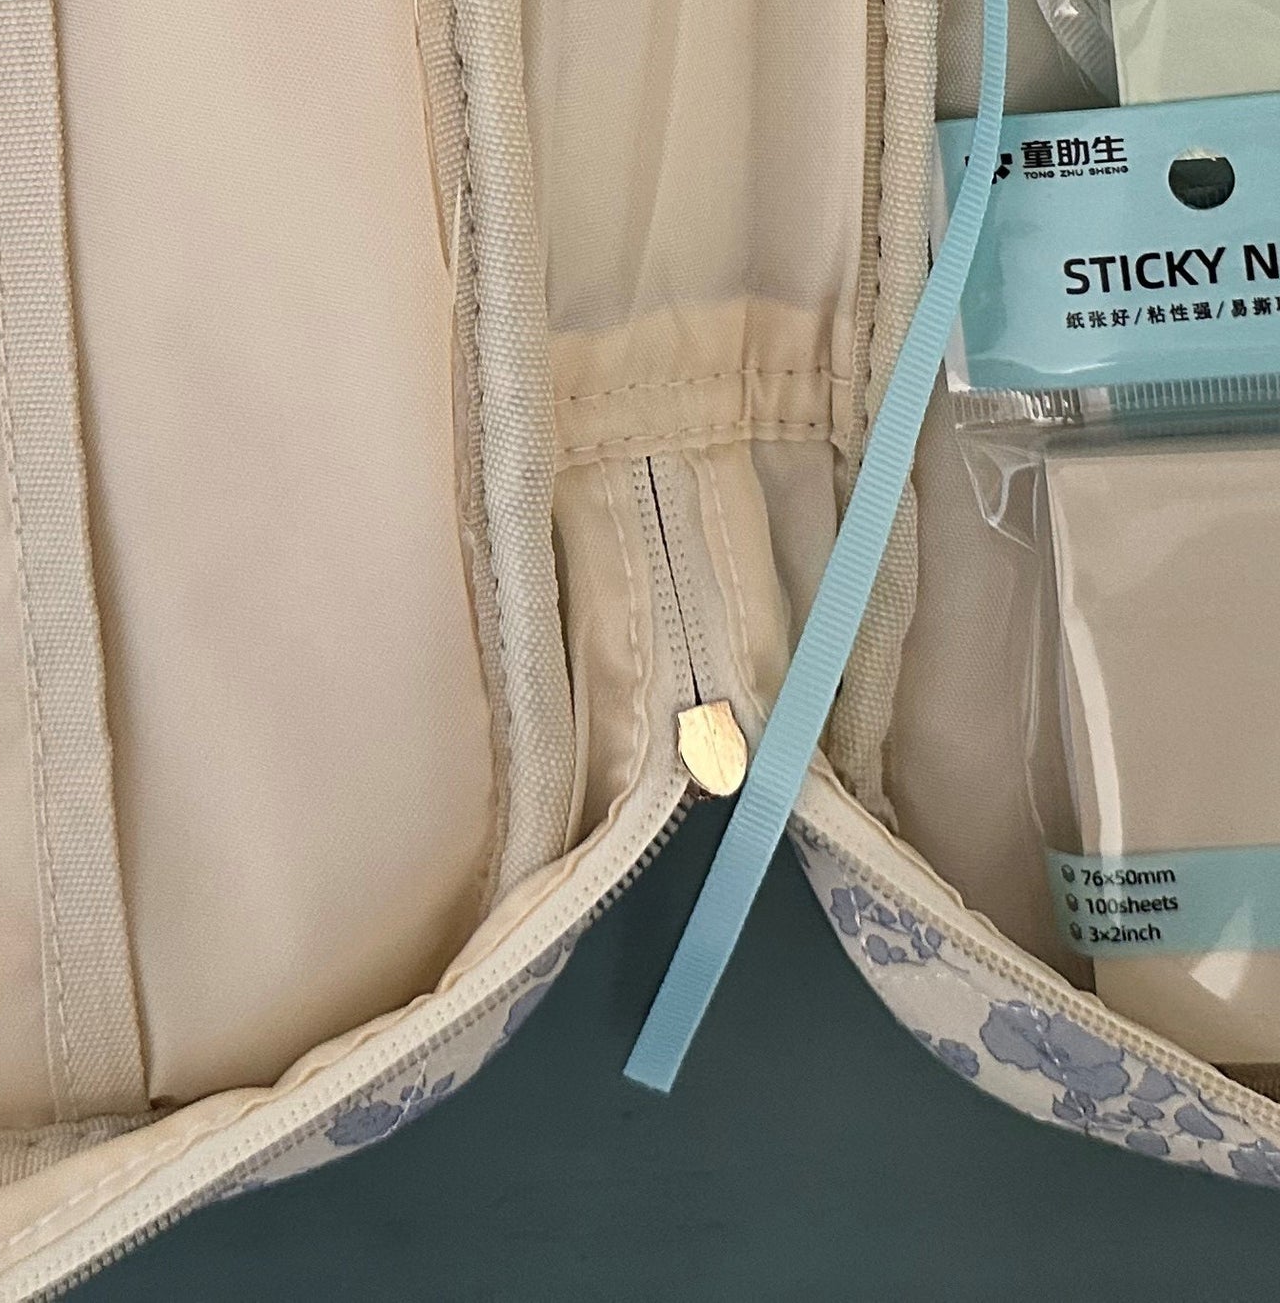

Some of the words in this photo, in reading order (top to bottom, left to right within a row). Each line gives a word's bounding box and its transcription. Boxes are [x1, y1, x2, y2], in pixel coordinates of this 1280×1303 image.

[1020, 135, 1128, 169] 童助生
[1023, 170, 1055, 180] TONG
[1059, 169, 1084, 177] ZHU
[1088, 165, 1129, 176] SHENG
[1063, 246, 1226, 295] STICKY
[1085, 895, 1179, 914] 100sheets
